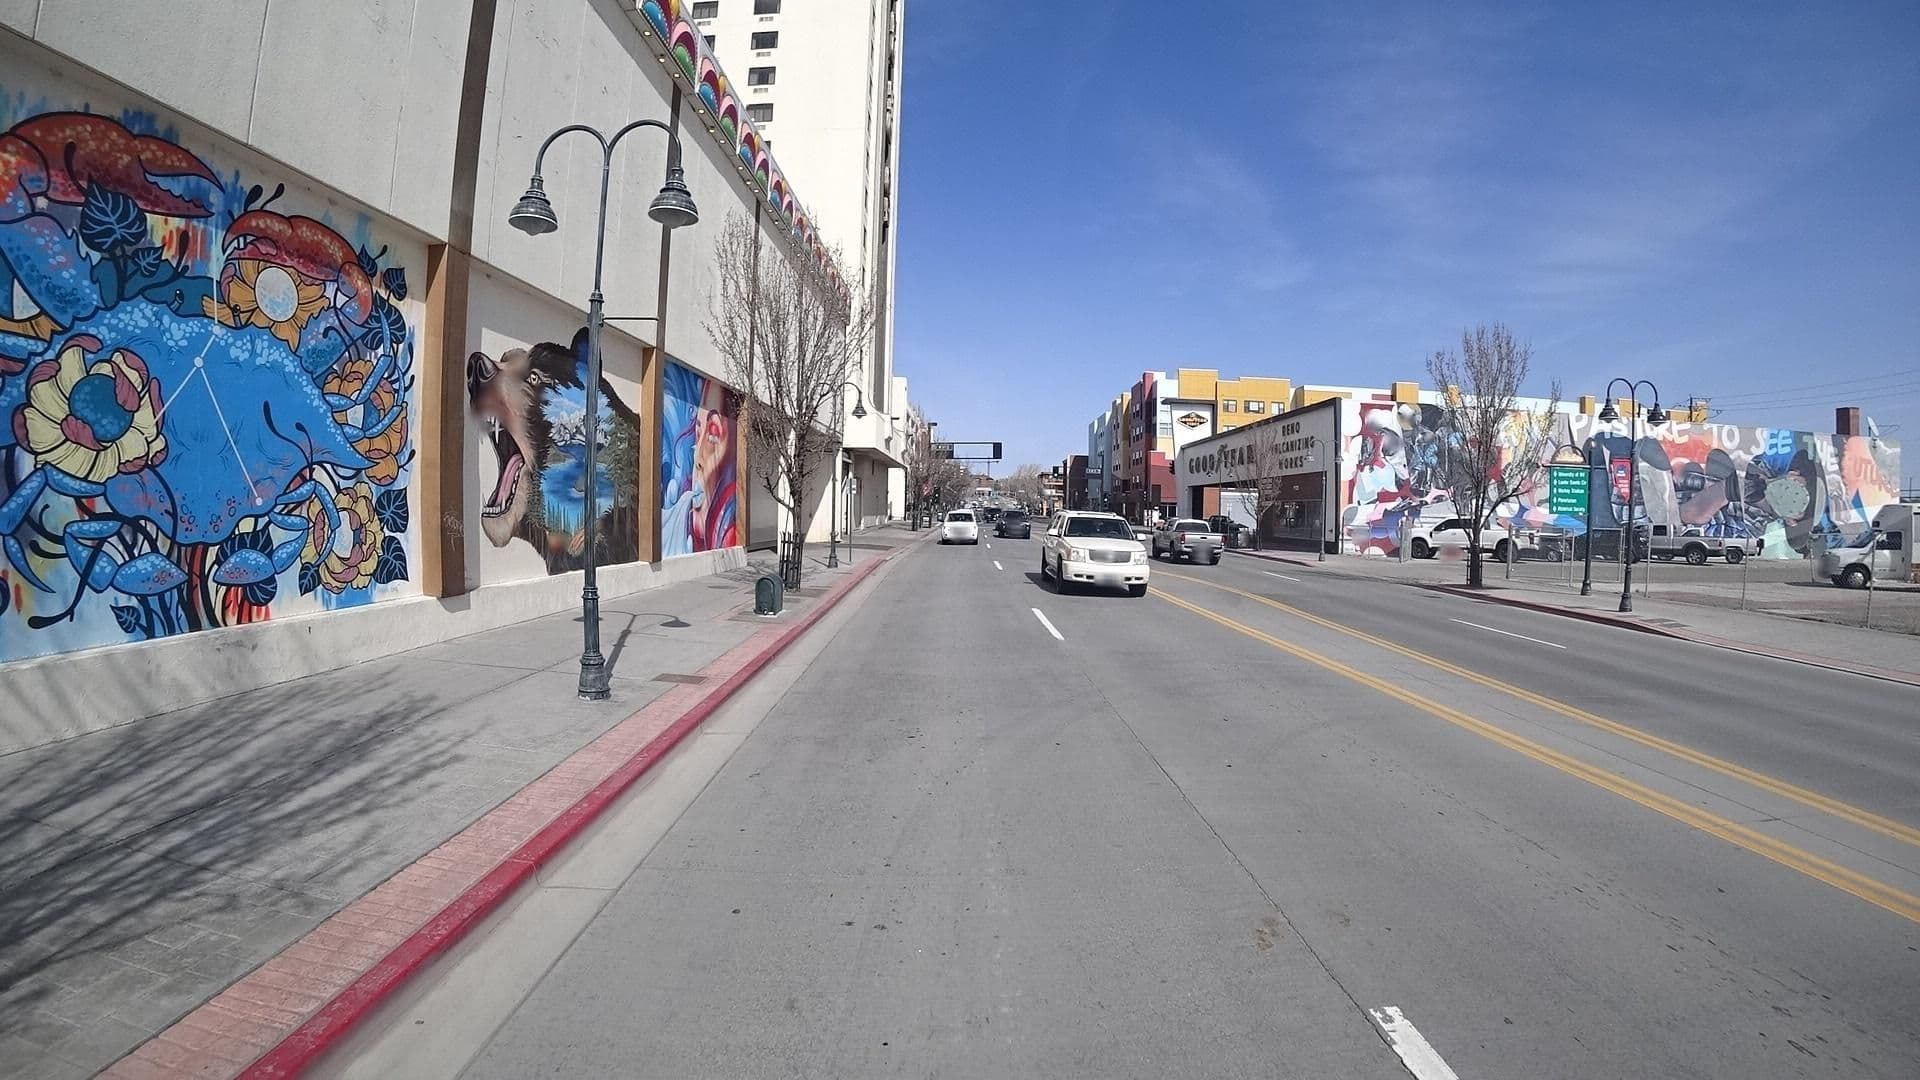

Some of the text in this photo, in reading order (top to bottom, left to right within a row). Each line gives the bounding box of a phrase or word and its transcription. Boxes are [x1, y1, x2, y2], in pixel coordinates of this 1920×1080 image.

[1282, 421, 1301, 437] RENO
[1704, 423, 1741, 450] TO
[1751, 427, 1793, 456] SEE
[1802, 434, 1839, 471] THE
[1188, 444, 1255, 475] GOODYEAR
[1278, 455, 1304, 471] WORKS
